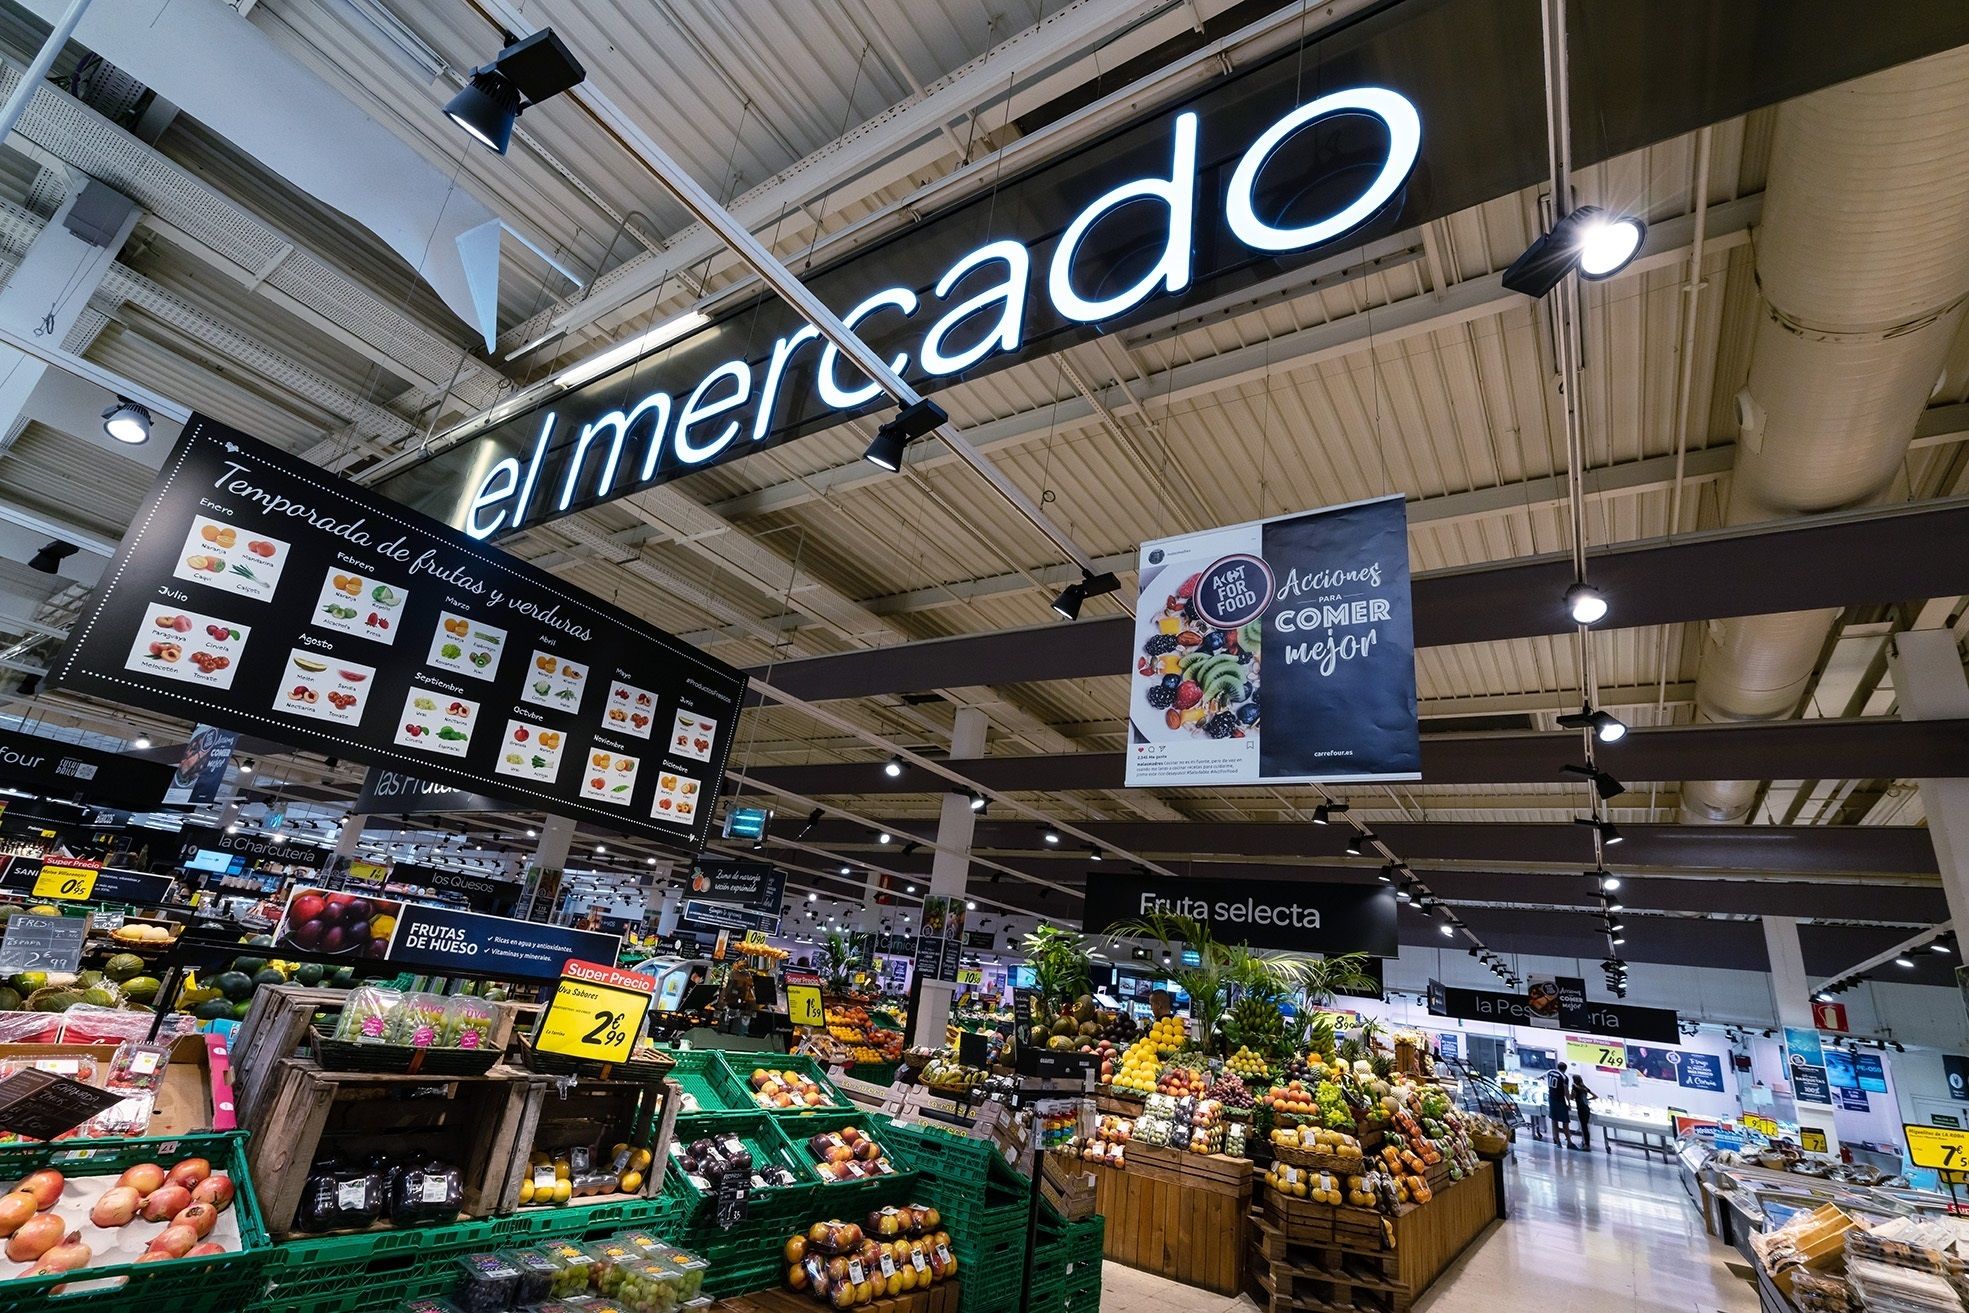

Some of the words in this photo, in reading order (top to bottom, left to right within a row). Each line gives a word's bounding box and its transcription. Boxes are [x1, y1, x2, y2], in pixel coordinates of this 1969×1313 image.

[467, 411, 558, 538] el
[560, 86, 1423, 511] mercado
[199, 497, 234, 516] Enero
[201, 543, 227, 555] Naranja
[214, 460, 372, 547] Temporada
[377, 536, 410, 562] de
[408, 548, 486, 595] frutas
[487, 588, 505, 607] y
[508, 598, 593, 642] verduras
[337, 551, 375, 573] Febrero
[1277, 562, 1382, 600] Acciones
[158, 586, 188, 602] Julio
[335, 592, 357, 602] Naranja
[1217, 580, 1248, 601] FOR
[1318, 593, 1343, 603] PARA
[445, 596, 471, 611] Marzo
[1217, 590, 1257, 616] FOOD
[1274, 598, 1392, 633] COMER
[152, 630, 187, 642] Paraguaya
[298, 633, 334, 650] Agosto
[540, 635, 557, 647] Abril
[205, 642, 230, 652] Ciruela
[1285, 628, 1377, 677] mejor
[193, 672, 218, 683] Tomate
[616, 667, 632, 680] Mayo
[414, 671, 464, 694] Septiembre
[513, 705, 544, 722] Octubre
[593, 733, 625, 751] Noviembre
[1313, 749, 1353, 758] carrefour.es
[55, 766, 77, 777] DAILY
[59, 757, 80, 769] SUSHI
[662, 759, 689, 773] Diciembre
[374, 769, 400, 796] las
[218, 834, 231, 848] la
[233, 837, 315, 863] Charcutería
[46, 857, 72, 867] Super
[73, 860, 100, 870] Precio
[431, 872, 449, 886] los
[450, 876, 494, 893] Quesos
[1140, 892, 1209, 920] Fruta
[1214, 897, 1321, 929] selecta
[409, 922, 466, 940] FRUTAS
[405, 935, 426, 949] DE
[429, 938, 478, 956] HUESO
[494, 936, 510, 945] Ricas
[491, 948, 520, 958] Vitaminas
[567, 963, 609, 982] Super
[609, 972, 650, 991] Precio
[557, 985, 571, 995] Uva
[571, 988, 599, 1000] Sabores
[1476, 996, 1492, 1014] la
[1549, 1076, 1558, 1089] 10
